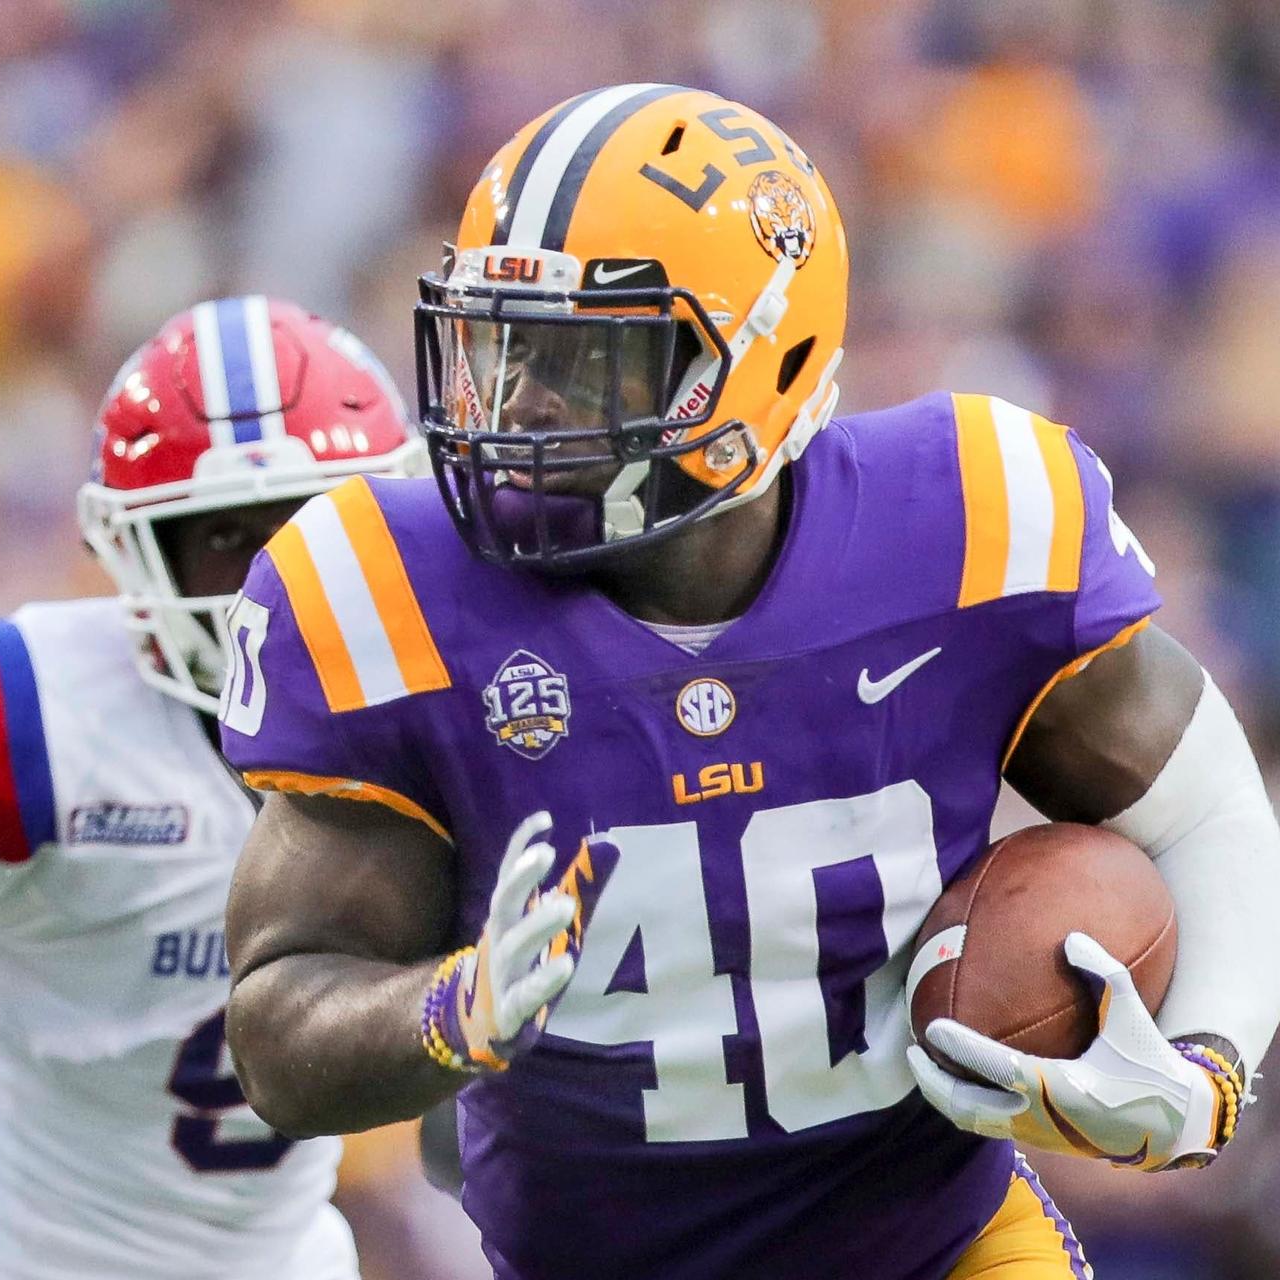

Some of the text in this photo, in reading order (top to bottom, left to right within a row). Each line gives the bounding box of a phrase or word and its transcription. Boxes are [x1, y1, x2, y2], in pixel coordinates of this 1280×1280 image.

[484, 255, 543, 284] LSU
[486, 677, 568, 723] 125
[680, 682, 732, 732] SEC
[672, 761, 765, 805] LSU
[544, 779, 942, 1143] 40
